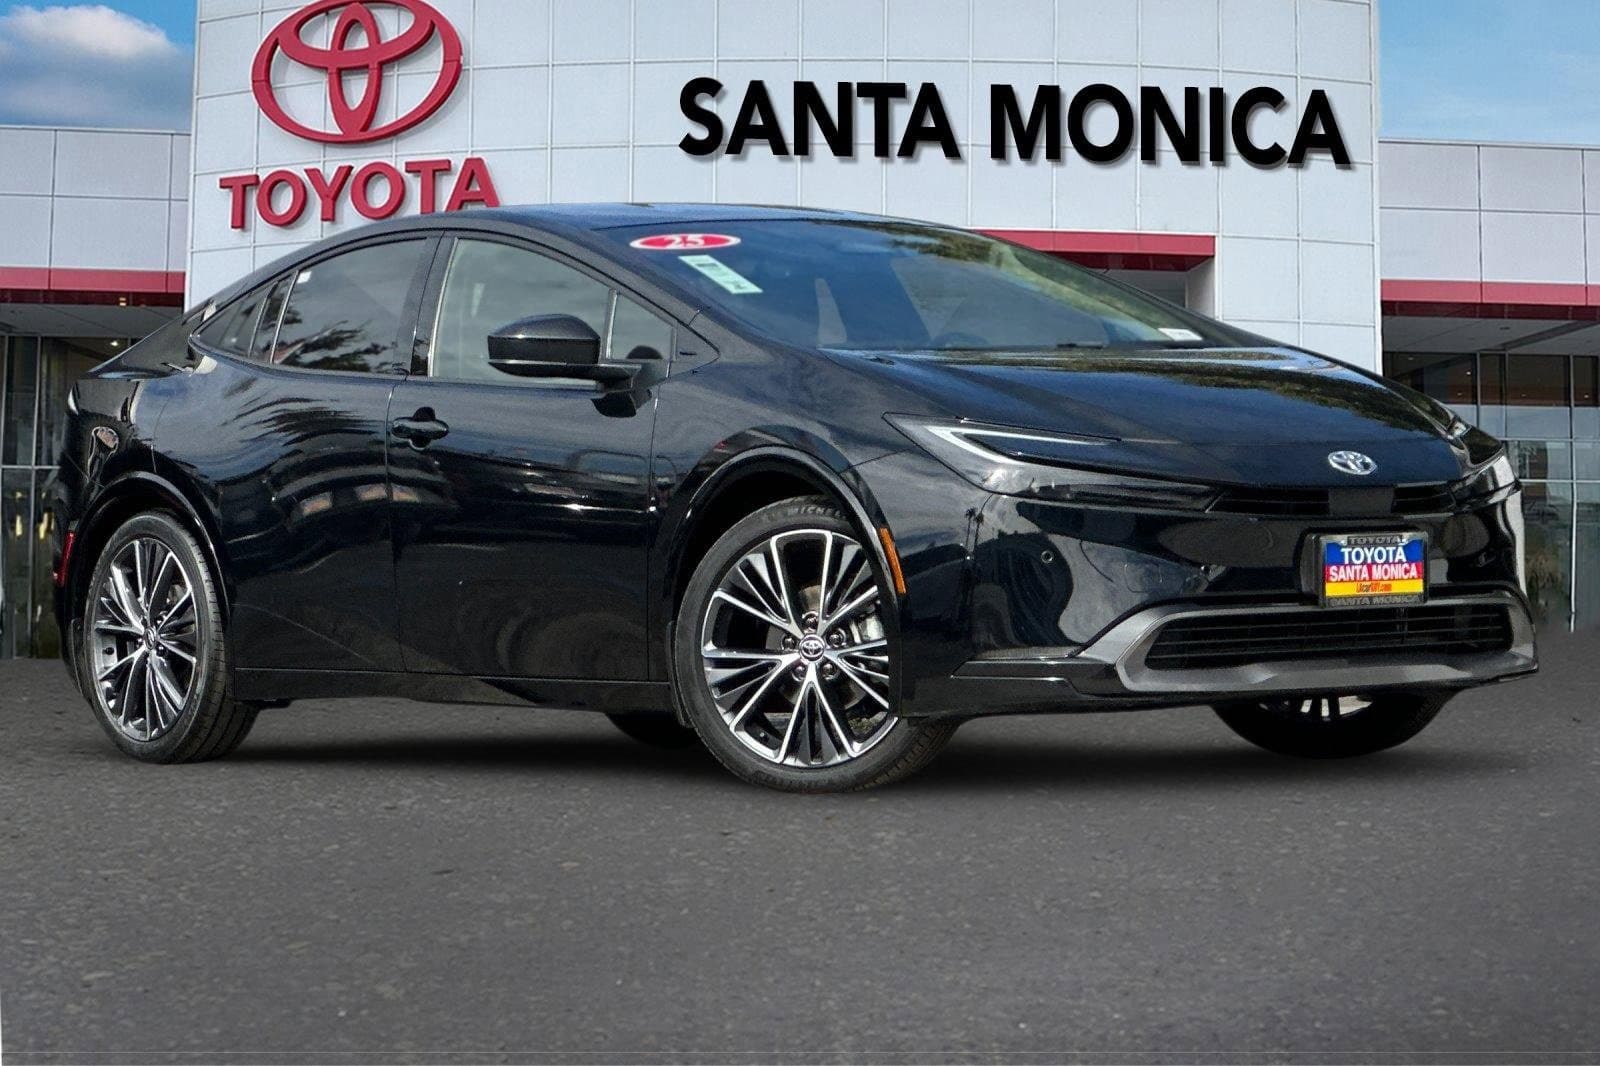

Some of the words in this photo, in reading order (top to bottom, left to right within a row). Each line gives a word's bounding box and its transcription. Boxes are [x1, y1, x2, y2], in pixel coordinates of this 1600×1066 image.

[680, 77, 961, 158] SANTA
[990, 83, 1352, 167] MONICA
[219, 157, 500, 230] TOYOTA
[664, 235, 705, 247] 25
[1348, 536, 1400, 545] TOYOTA
[1341, 546, 1407, 564] TOYOTA
[1330, 564, 1369, 582] SANTA
[1372, 563, 1418, 580] MONICA
[1330, 597, 1370, 606] SANTA
